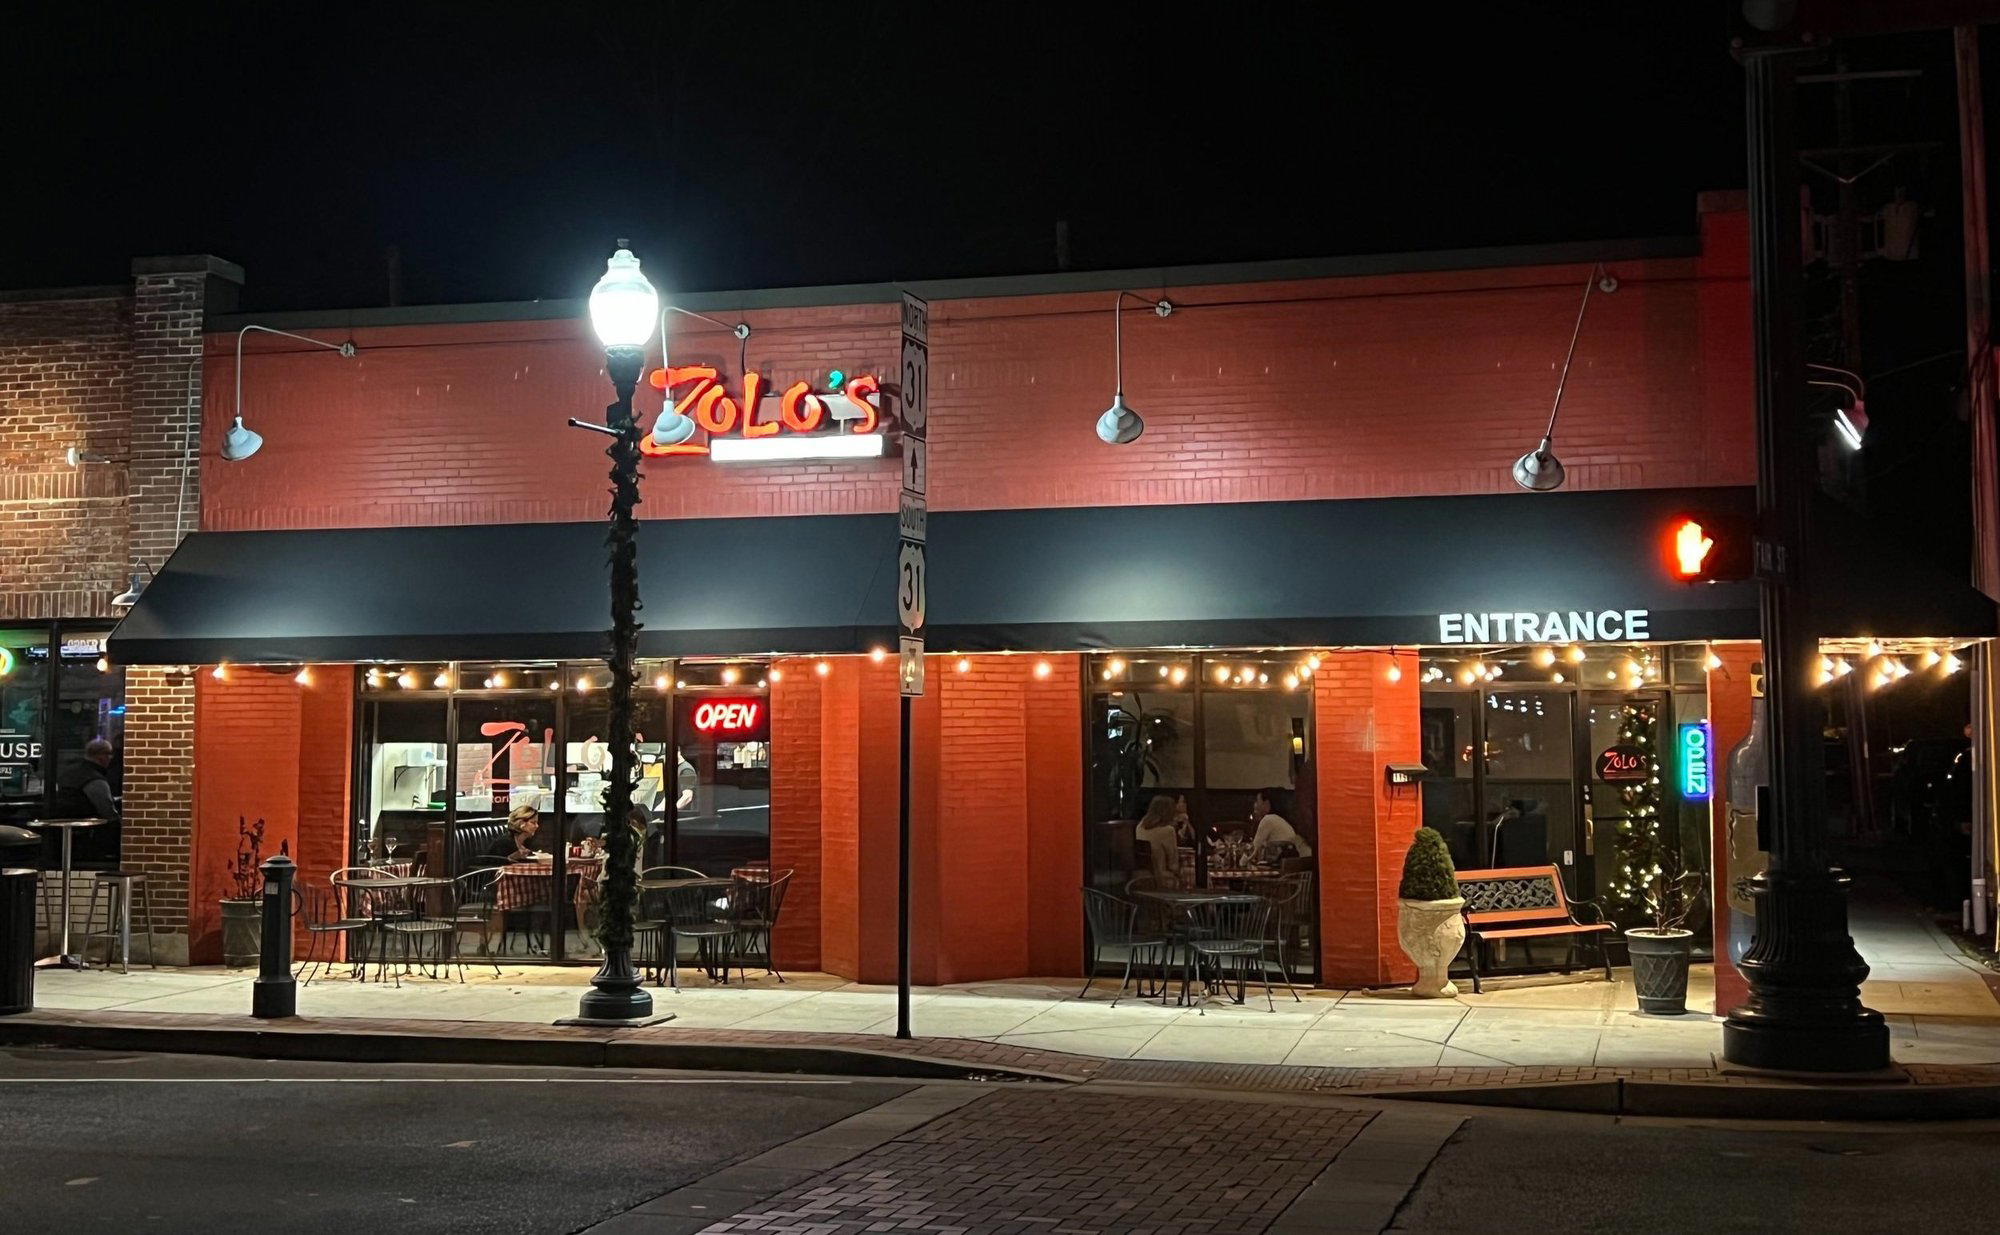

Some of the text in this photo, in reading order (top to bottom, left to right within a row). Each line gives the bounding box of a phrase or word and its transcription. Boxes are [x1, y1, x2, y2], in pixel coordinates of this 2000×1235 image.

[903, 300, 928, 334] NORTH
[905, 360, 921, 412] 31
[901, 503, 925, 532] SOUTH
[902, 561, 920, 612] 31
[1438, 609, 1649, 642] ENTRANCE
[695, 703, 758, 729] OPEN
[1686, 728, 1706, 794] OPEN
